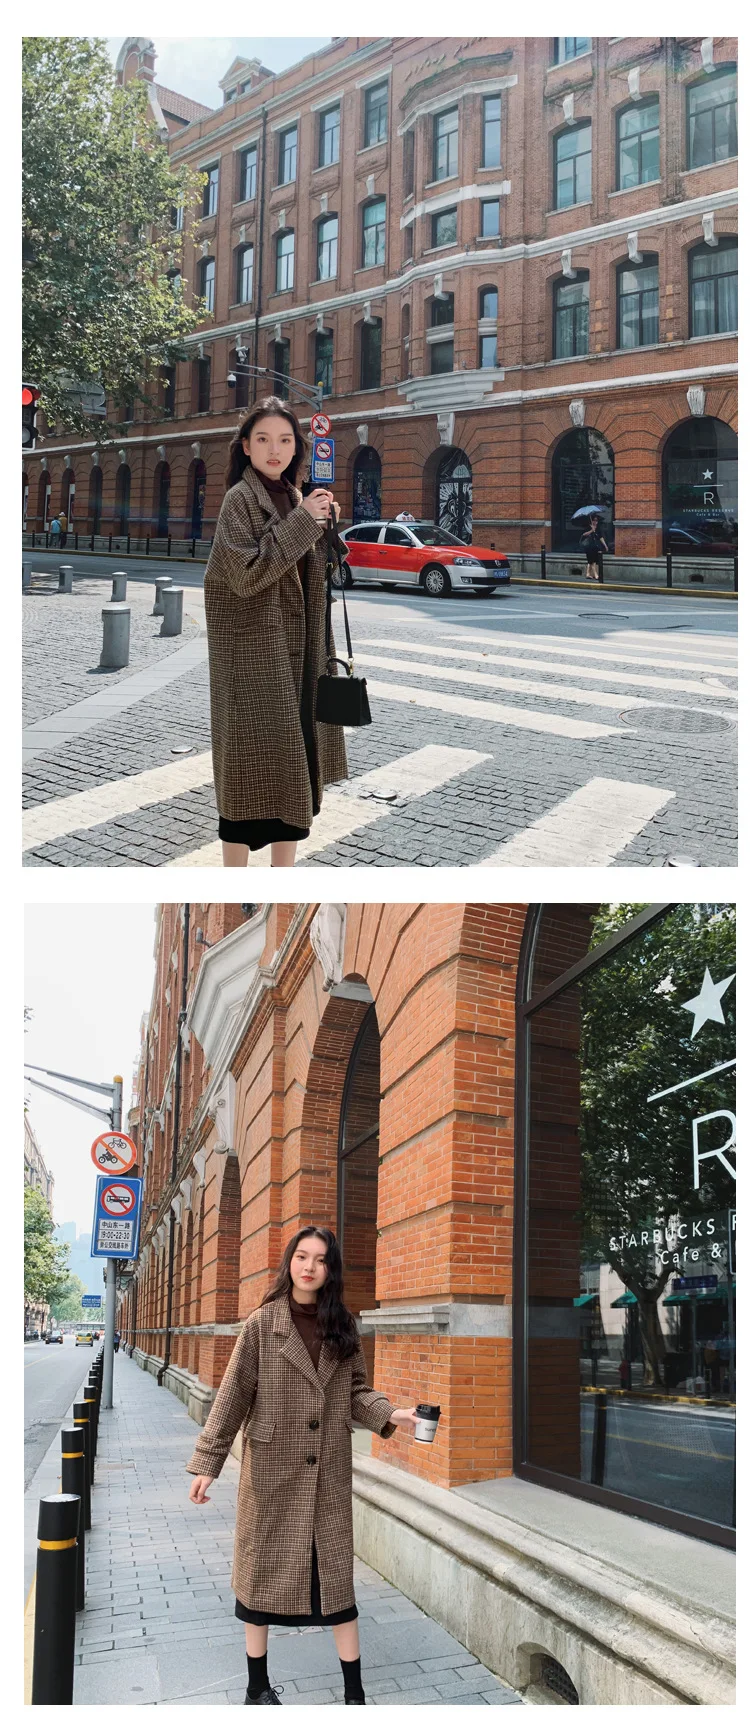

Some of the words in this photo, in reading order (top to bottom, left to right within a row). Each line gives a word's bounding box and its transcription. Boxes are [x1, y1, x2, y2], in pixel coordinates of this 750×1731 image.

[703, 491, 714, 504] R
[692, 1109, 736, 1189] R
[101, 1221, 130, 1229] 中山东一路
[609, 1218, 715, 1251] STARBUCKS
[661, 1246, 699, 1264] Cafe
[711, 1243, 722, 1258] &
